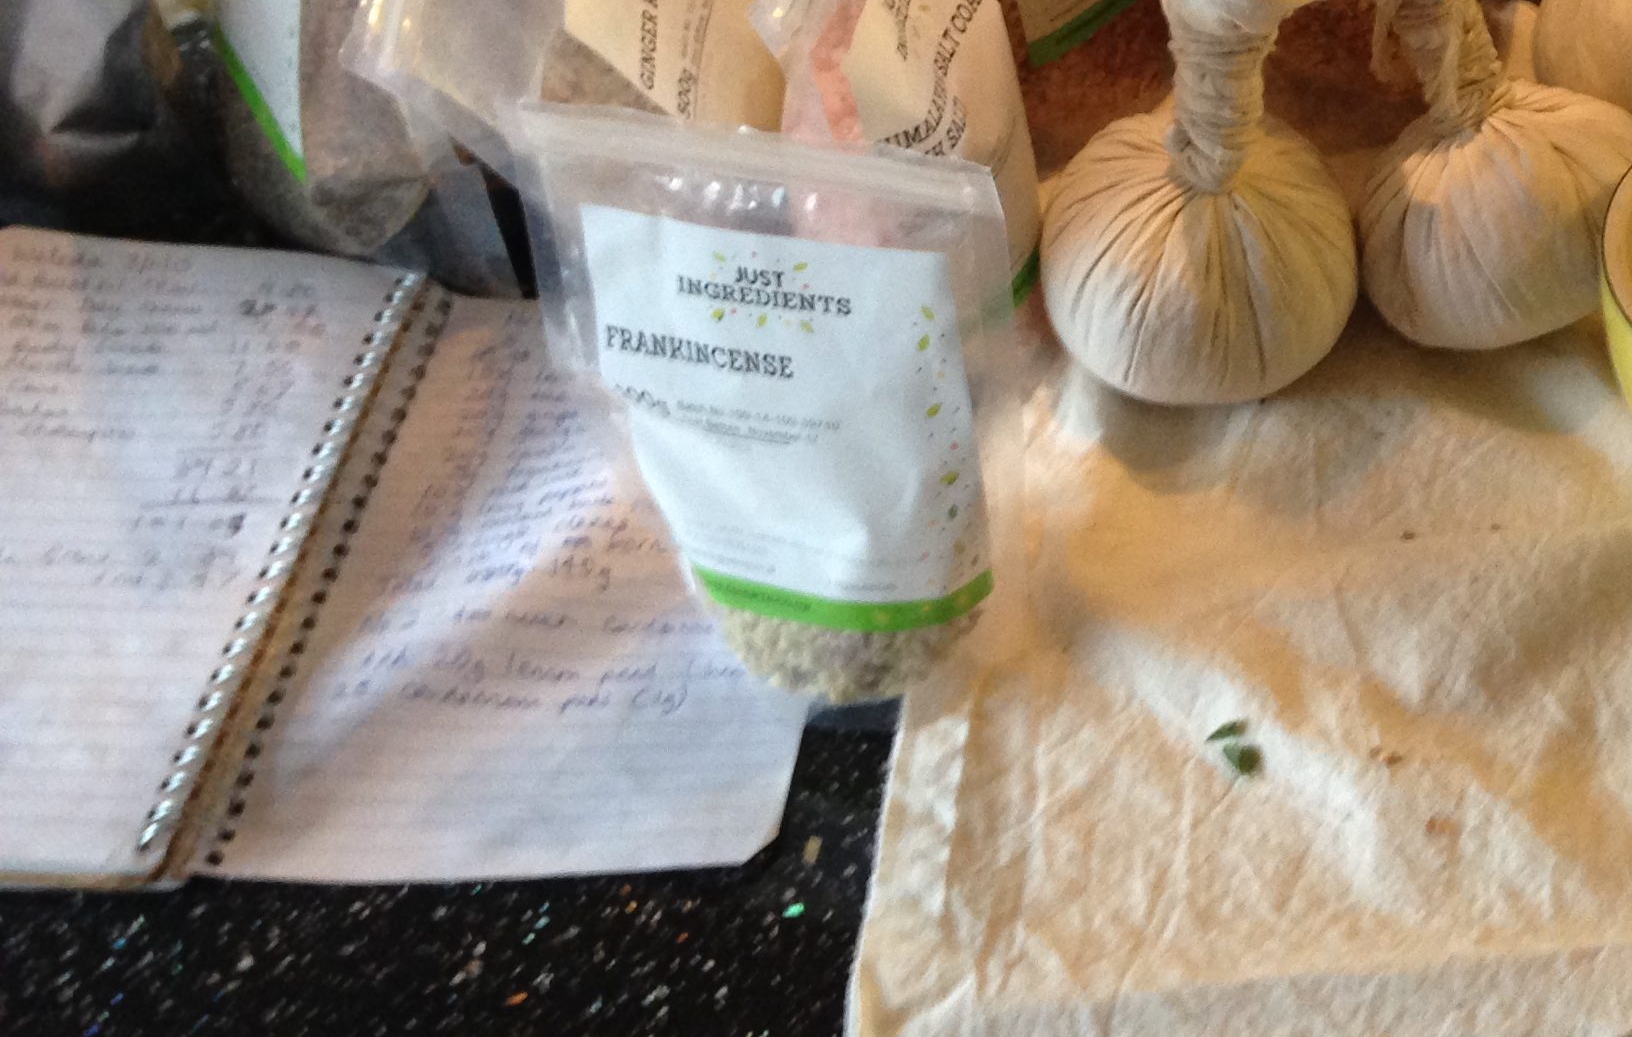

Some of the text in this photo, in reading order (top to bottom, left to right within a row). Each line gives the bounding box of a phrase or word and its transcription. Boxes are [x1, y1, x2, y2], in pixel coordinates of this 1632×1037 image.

[640, 9, 659, 91] GINGER
[934, 28, 960, 77] SALT
[677, 274, 852, 316] INGREDIENTS
[735, 266, 785, 288] JUST
[605, 324, 796, 379] FRANKINCENSE
